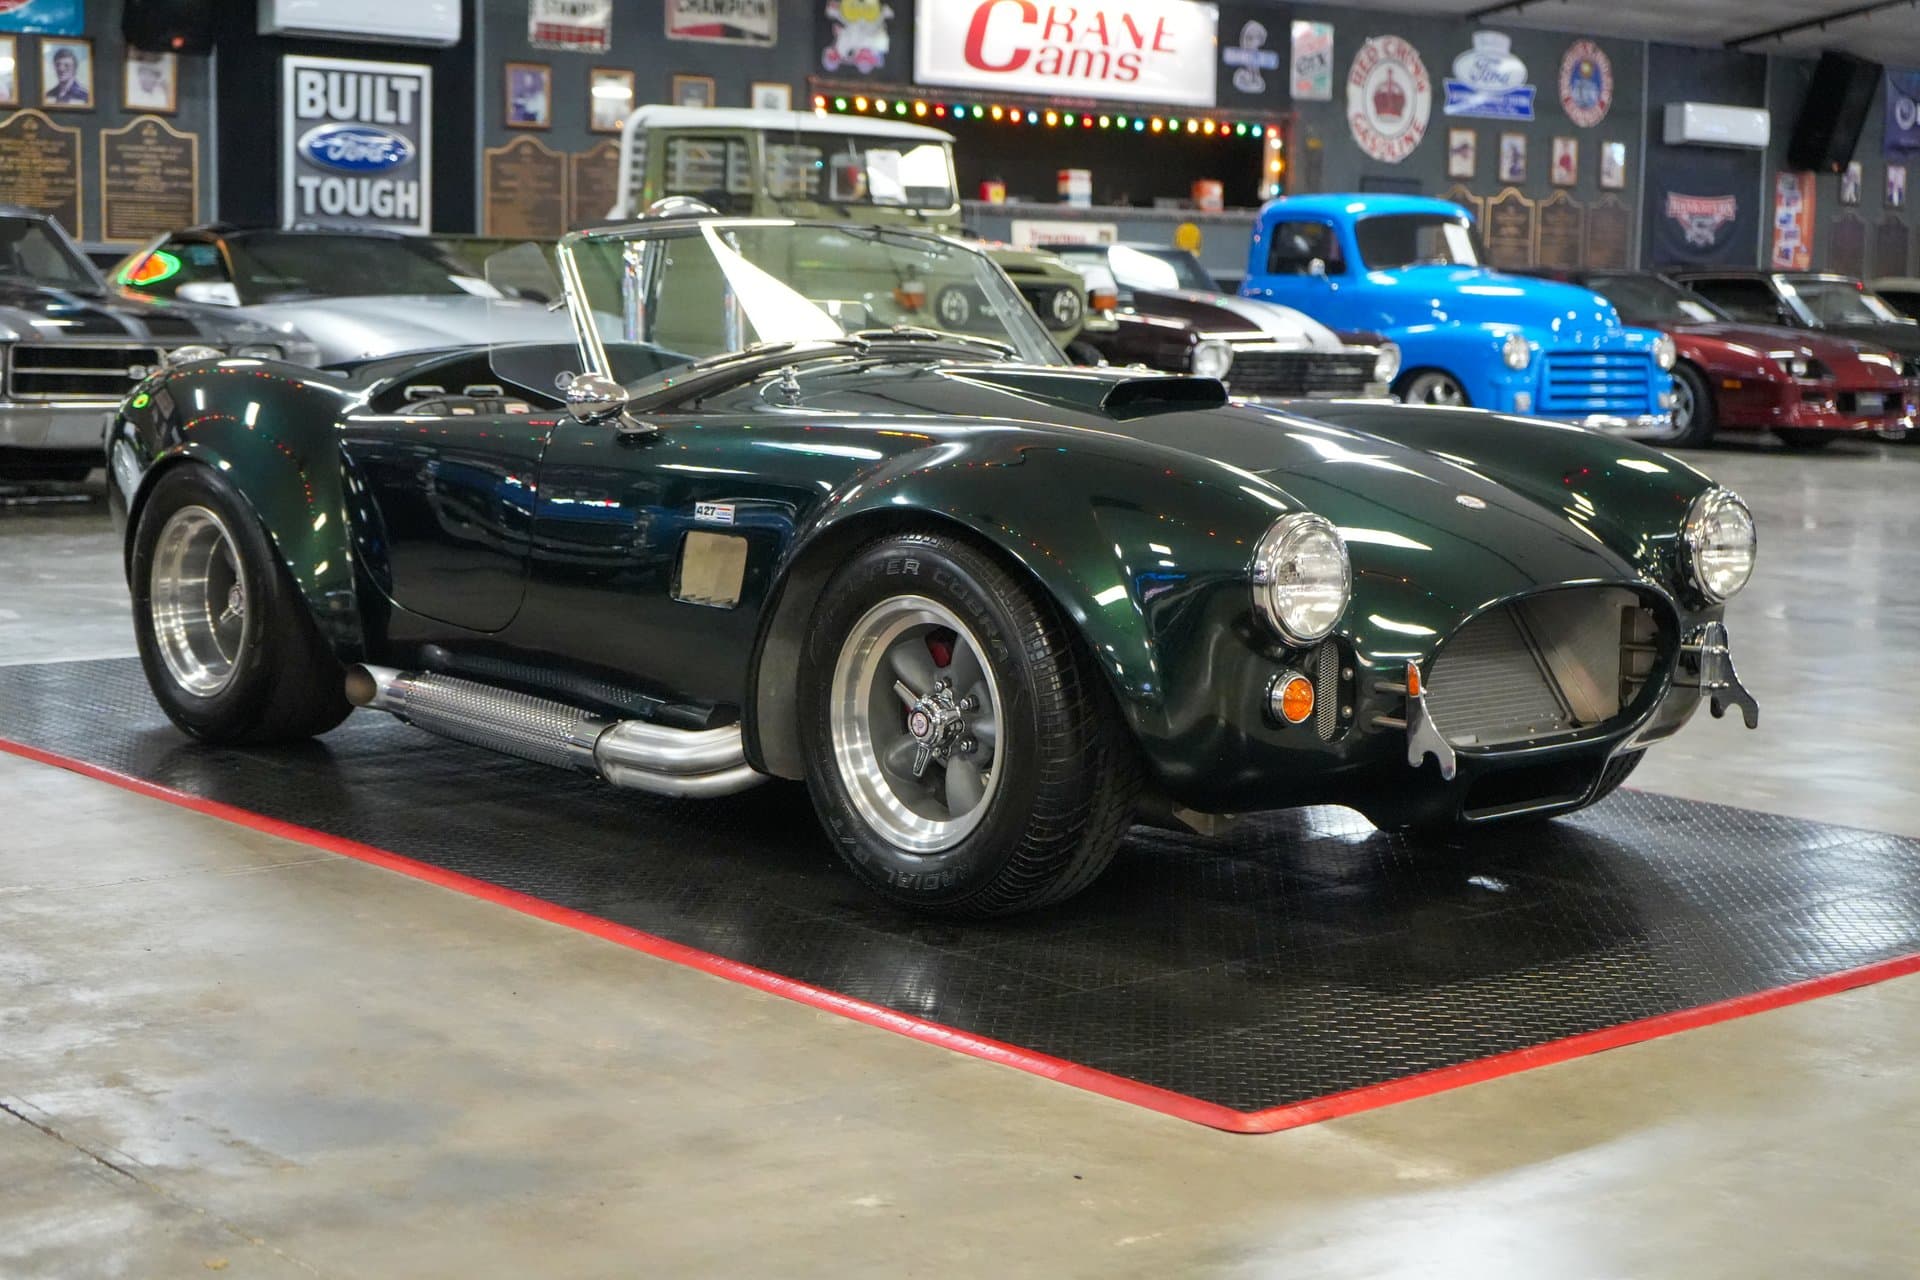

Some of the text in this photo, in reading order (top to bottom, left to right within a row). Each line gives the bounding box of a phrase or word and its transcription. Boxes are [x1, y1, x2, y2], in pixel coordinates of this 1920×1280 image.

[1350, 46, 1378, 86] RED
[297, 69, 420, 125] BUILT
[297, 175, 419, 220] TOUGH
[696, 505, 716, 516] 427
